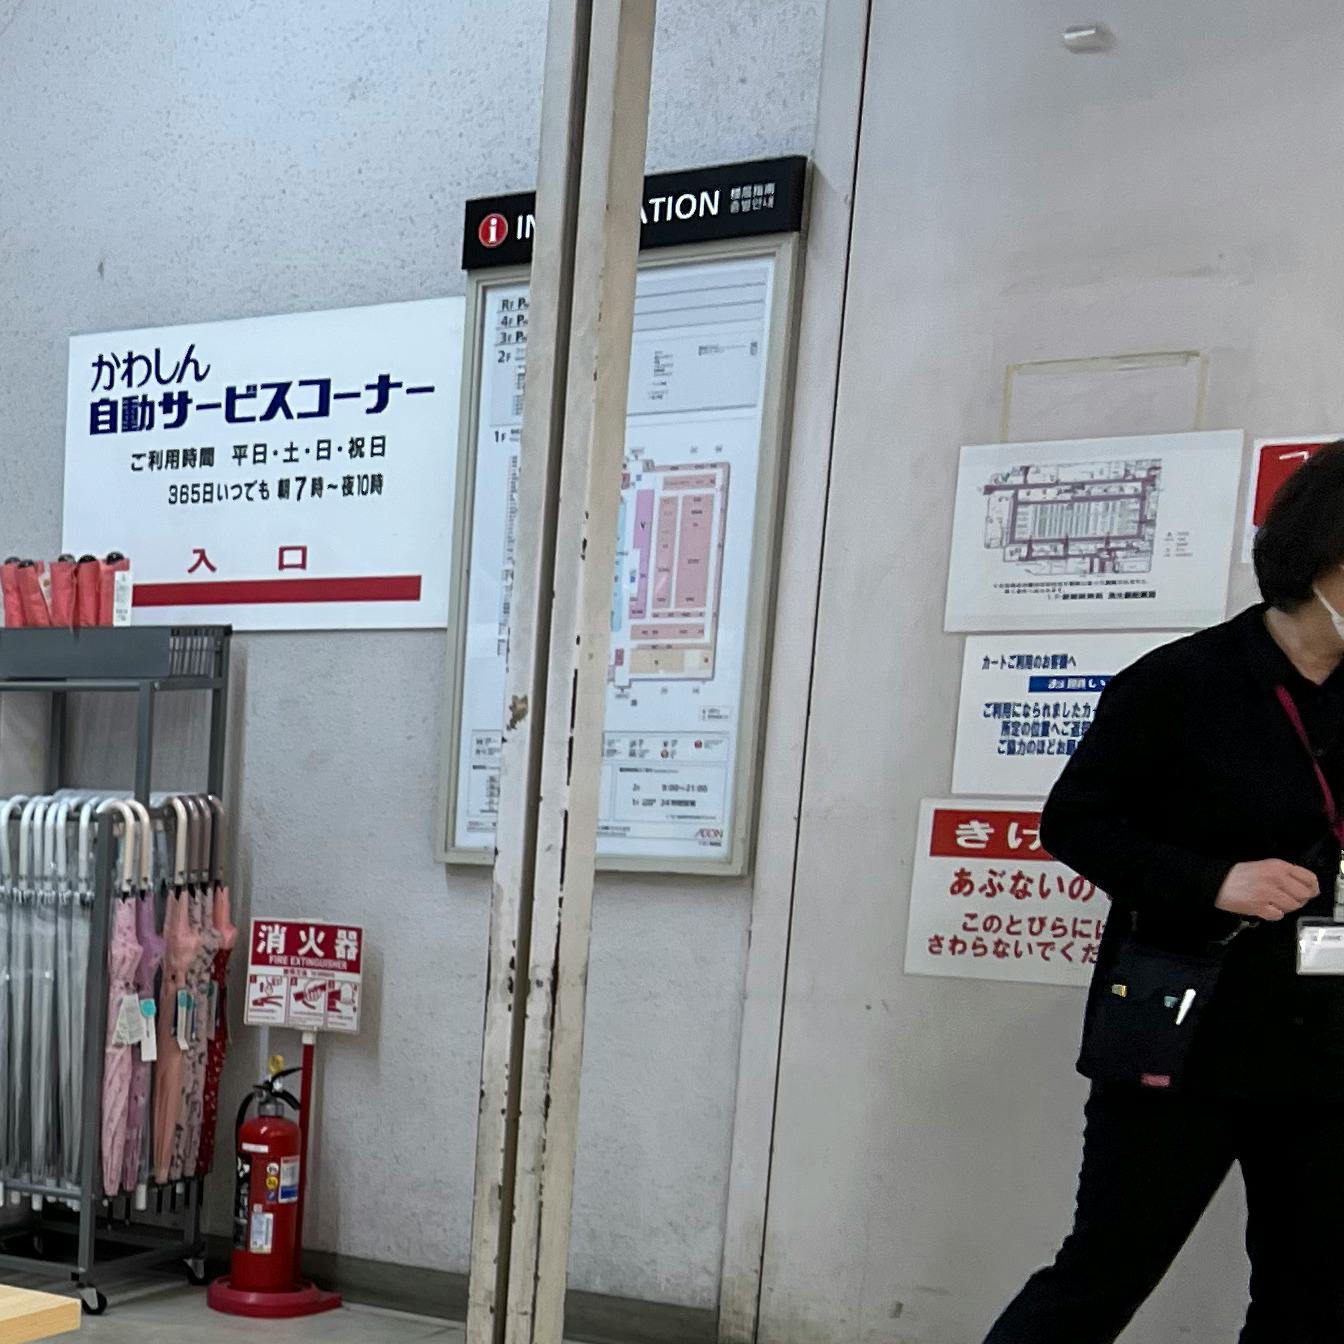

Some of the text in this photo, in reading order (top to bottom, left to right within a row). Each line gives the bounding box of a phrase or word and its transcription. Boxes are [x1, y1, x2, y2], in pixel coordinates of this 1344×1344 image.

[91, 344, 210, 392] かわしん
[90, 374, 435, 435] 自動サービスコーナー
[131, 435, 387, 472] ご利用時間 平日・土・日・祝日
[168, 479, 270, 505] 365日いつでも
[257, 924, 358, 960] 消火器
[269, 955, 288, 964] FIRE
